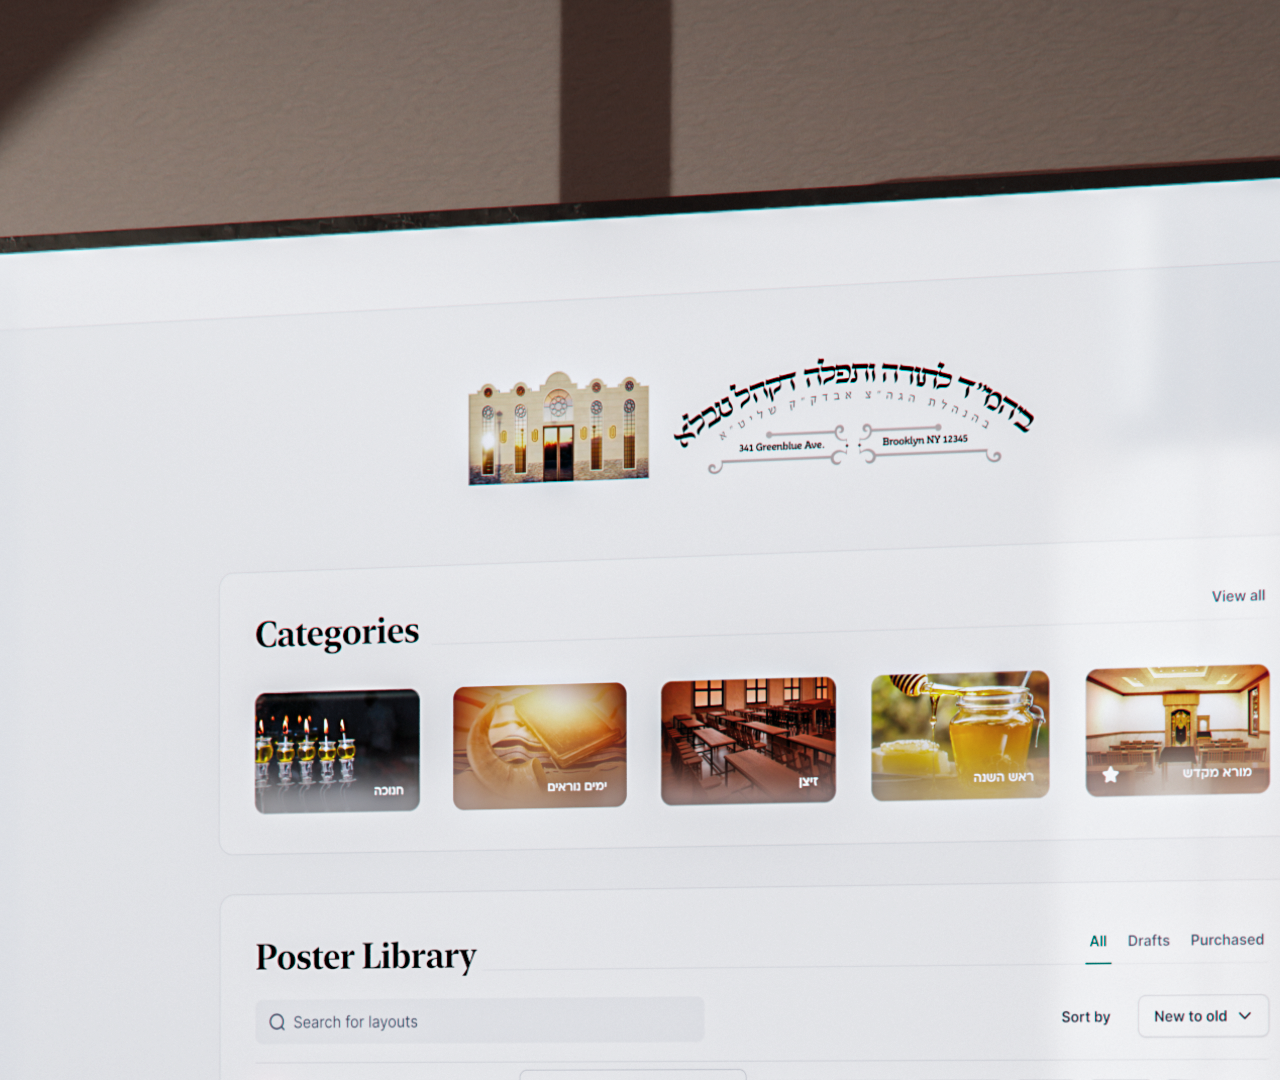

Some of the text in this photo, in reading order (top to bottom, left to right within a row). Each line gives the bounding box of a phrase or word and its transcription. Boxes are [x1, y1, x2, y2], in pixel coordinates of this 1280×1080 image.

[803, 358, 876, 389] ותפלה
[882, 362, 953, 390] לתורה
[729, 371, 797, 408] דקהל
[673, 397, 734, 448] טבלא
[739, 440, 825, 452] 341 Greenblue Ave.
[882, 434, 969, 448] Brooklyn NY 12345
[1211, 588, 1266, 603] View all
[255, 617, 420, 654] Categories
[972, 770, 1035, 784] ראש השנה
[1182, 766, 1253, 780] מורא מקדש
[373, 784, 404, 797] חנוכה
[547, 780, 608, 793] ימים נוראים
[1089, 935, 1107, 947] All
[1128, 934, 1170, 947] Drafts
[1190, 932, 1264, 947] Purchased
[255, 941, 477, 977] Poster Library
[293, 1014, 418, 1032] Search for layouts
[1061, 1010, 1111, 1026] Sort by
[1154, 1009, 1228, 1023] New to old
